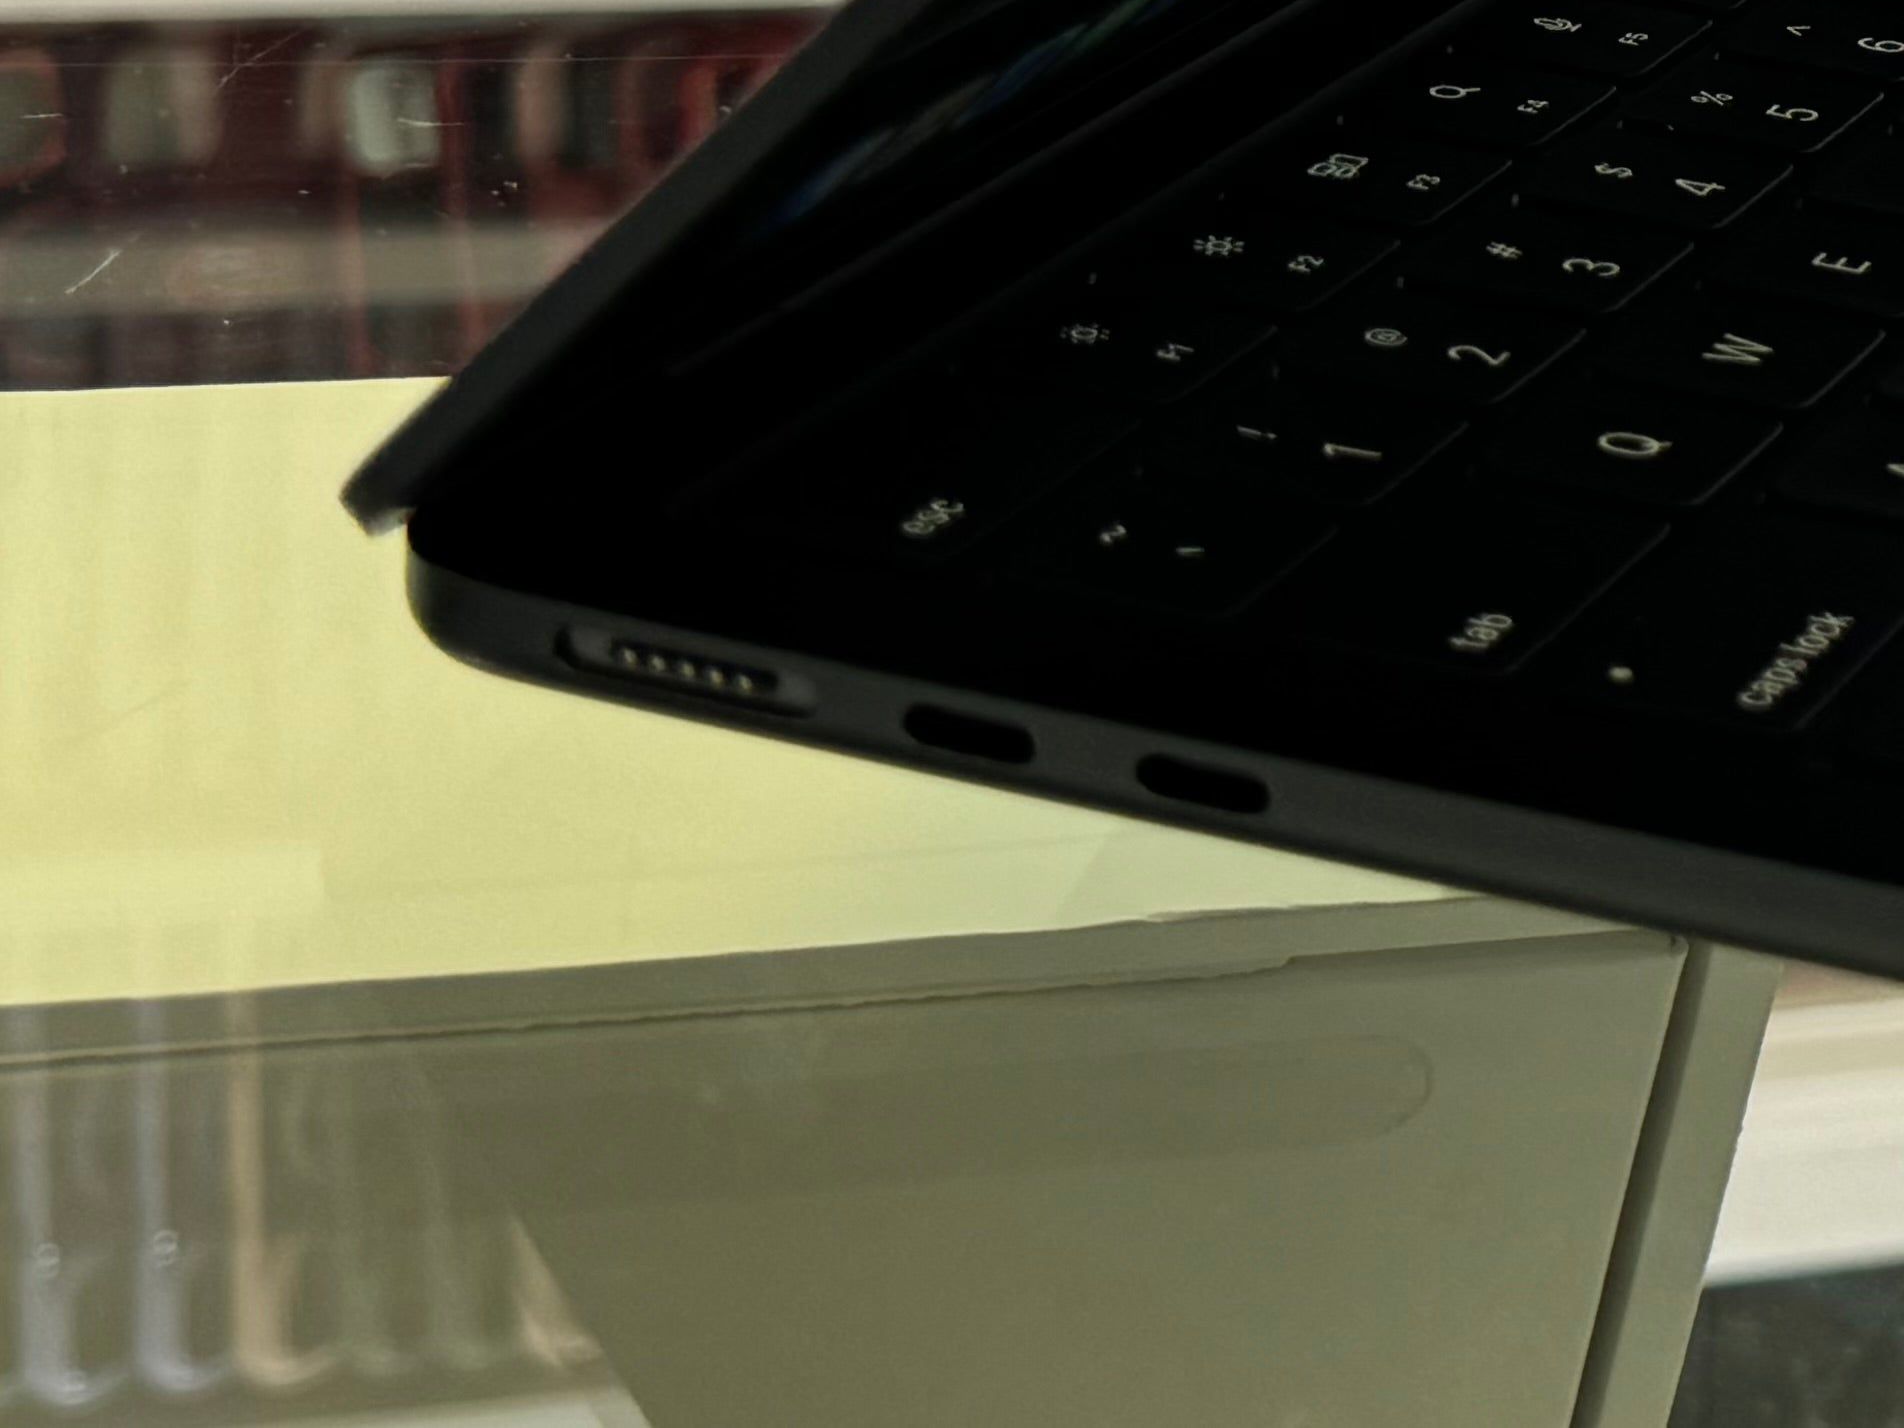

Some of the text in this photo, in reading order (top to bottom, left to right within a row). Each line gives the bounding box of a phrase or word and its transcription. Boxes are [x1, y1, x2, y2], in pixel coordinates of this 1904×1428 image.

[1517, 99, 1549, 114] F4
[1690, 90, 1734, 106] %
[1765, 104, 1819, 122] 5
[1594, 162, 1633, 178] $
[1406, 173, 1441, 191] F3
[1675, 178, 1726, 196] 4
[1486, 242, 1521, 258] #
[1562, 258, 1621, 277] 3
[1811, 252, 1872, 274] E
[1364, 327, 1408, 347] @
[1447, 345, 1510, 366] 2
[1702, 332, 1773, 363] W
[1323, 442, 1381, 457] 1
[1598, 431, 1671, 456] Q
[900, 497, 966, 537] esc
[1447, 612, 1514, 651] tab
[1736, 610, 1855, 711] caps lock
